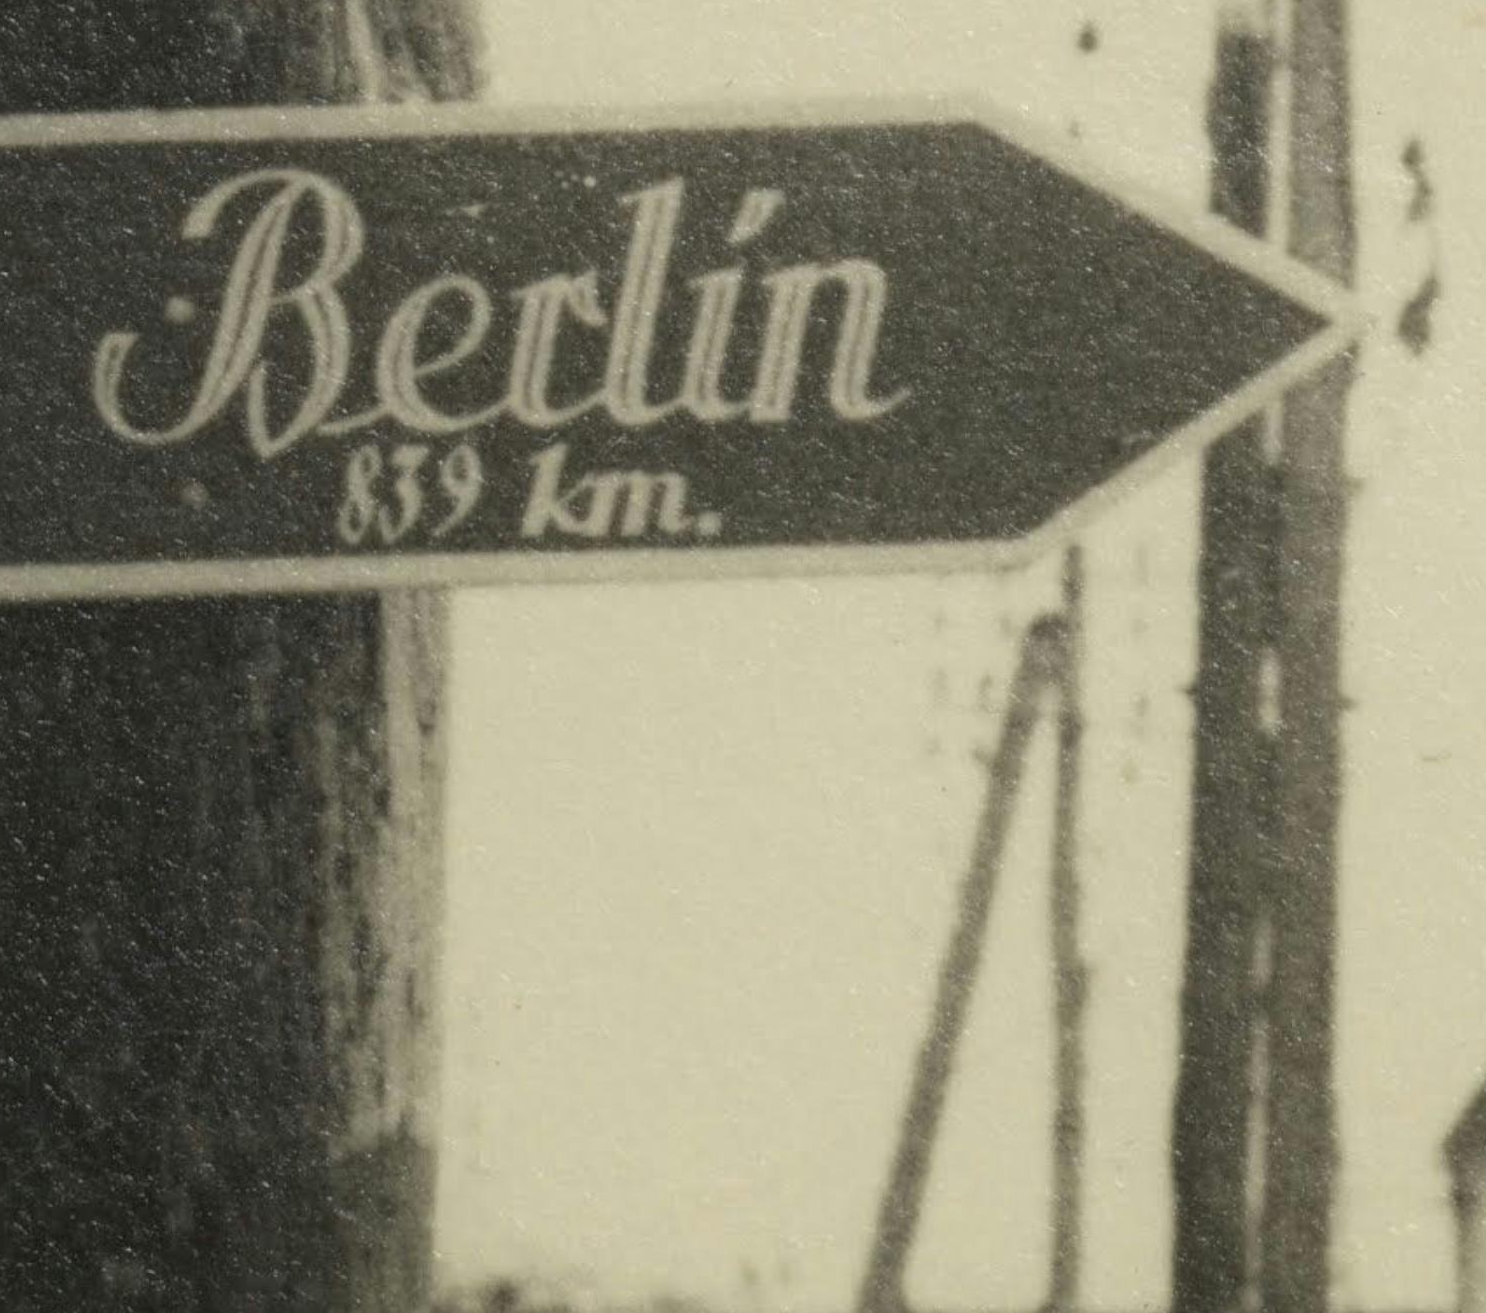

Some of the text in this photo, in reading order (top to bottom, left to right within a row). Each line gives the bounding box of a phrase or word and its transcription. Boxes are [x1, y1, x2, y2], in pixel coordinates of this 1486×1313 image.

[93, 169, 912, 459] Berlin
[339, 443, 721, 545] 839 km.
